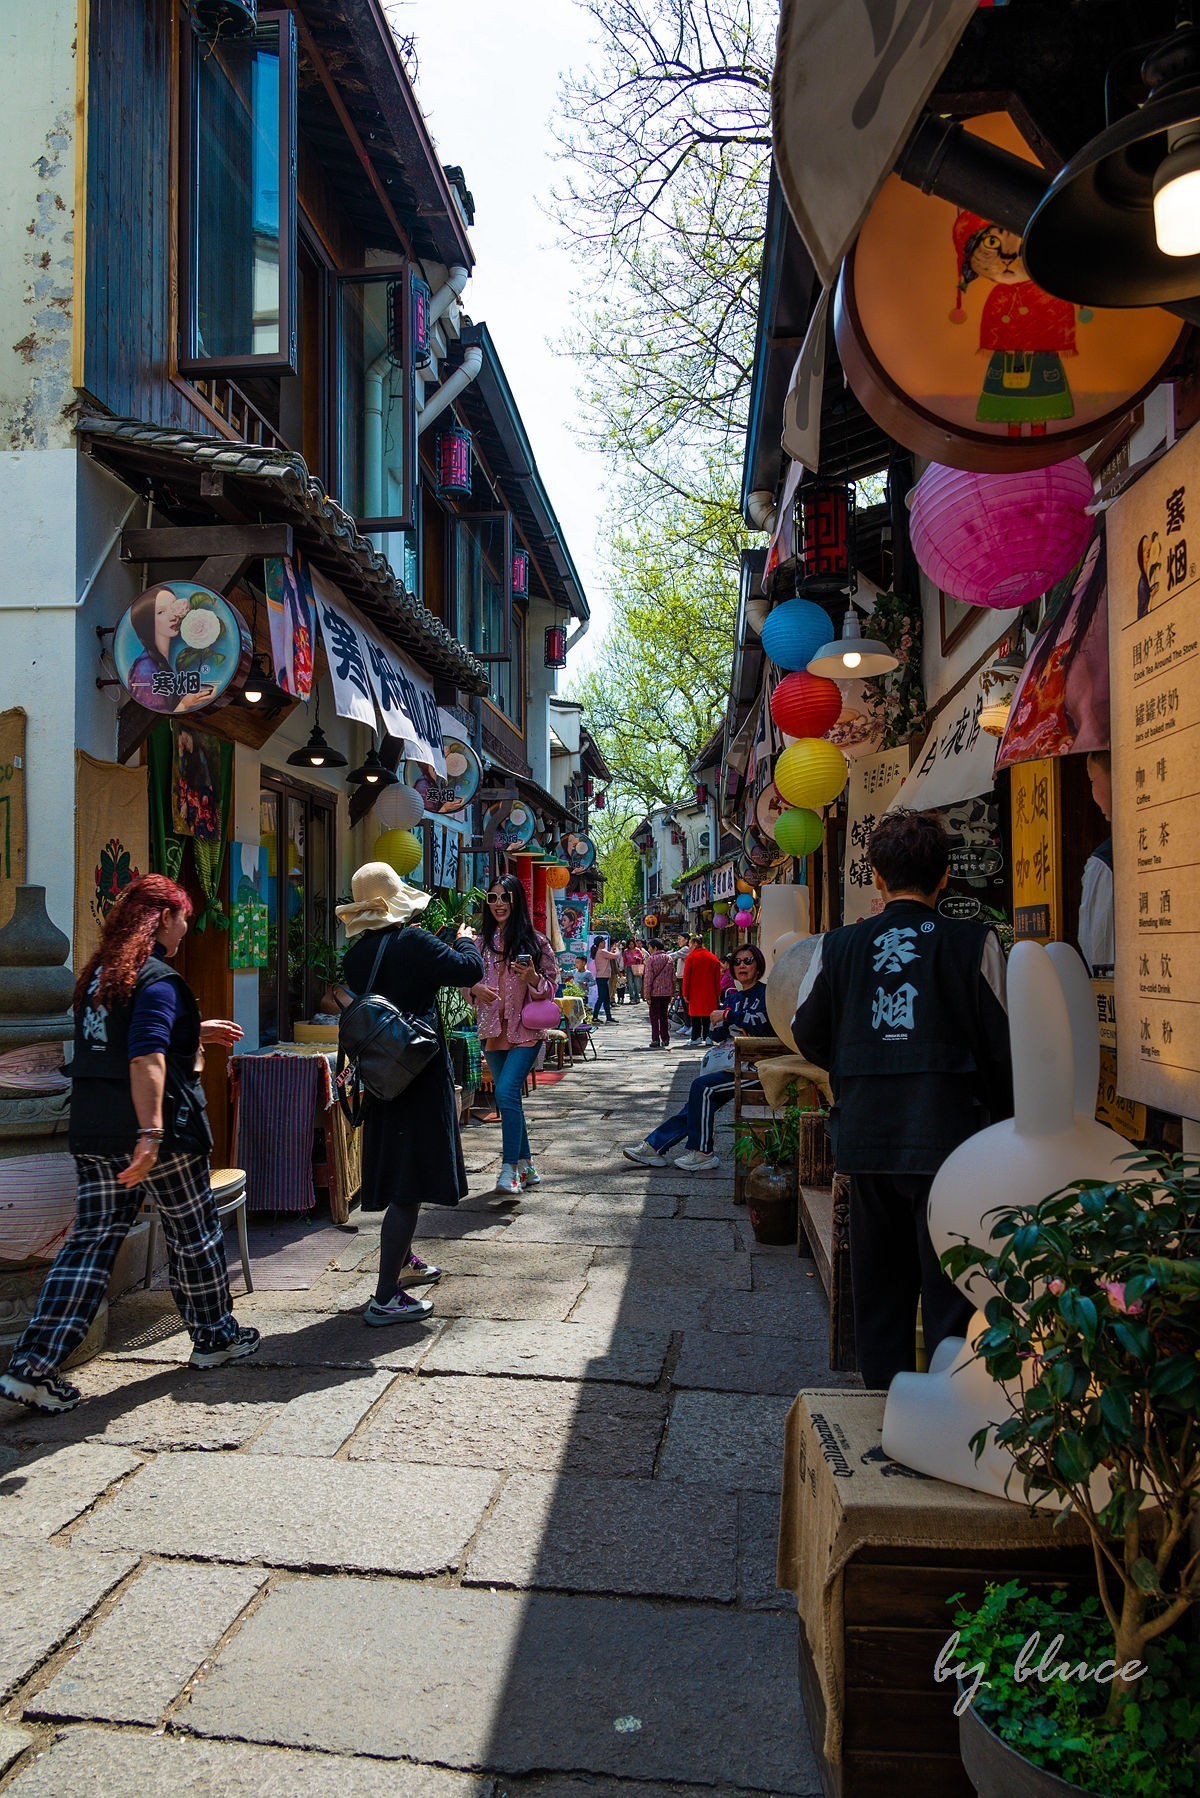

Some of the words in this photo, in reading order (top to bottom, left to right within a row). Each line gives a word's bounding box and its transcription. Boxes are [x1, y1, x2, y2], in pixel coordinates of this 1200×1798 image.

[1166, 486, 1187, 591] 寒烟
[1133, 622, 1176, 668] 围炉煮茶
[1134, 668, 1145, 681] Cook
[1145, 664, 1154, 675] Tea
[1154, 655, 1172, 672] Around
[1172, 649, 1182, 661] The
[1183, 641, 1198, 655] Stove
[152, 671, 201, 696] 寒烟
[1135, 687, 1179, 728] 罐罐烤奶
[1150, 723, 1164, 737] baked
[1165, 718, 1176, 730] milk
[1135, 757, 1168, 791] 咖啡
[426, 787, 455, 803] 寒烟
[1015, 773, 1049, 832] 寒烟
[1136, 794, 1150, 805] Coffee
[1138, 821, 1170, 851] 花茶
[1015, 834, 1050, 892] 咖啡
[1137, 857, 1152, 867] Flower
[1153, 854, 1162, 865] Tea
[1139, 889, 1171, 914] 调酒
[1138, 918, 1158, 928] Blending
[1159, 917, 1171, 926] Wine
[871, 927, 921, 1030] 寒烟
[1139, 953, 1172, 978] 冰饮
[1139, 982, 1156, 993] Ice-cold
[1157, 983, 1171, 994] Drink
[1140, 1017, 1173, 1044] 冰粉
[1141, 1045, 1151, 1057] Bing
[1151, 1048, 1160, 1057] Fen
[810, 1413, 855, 1478] Quillabamba
